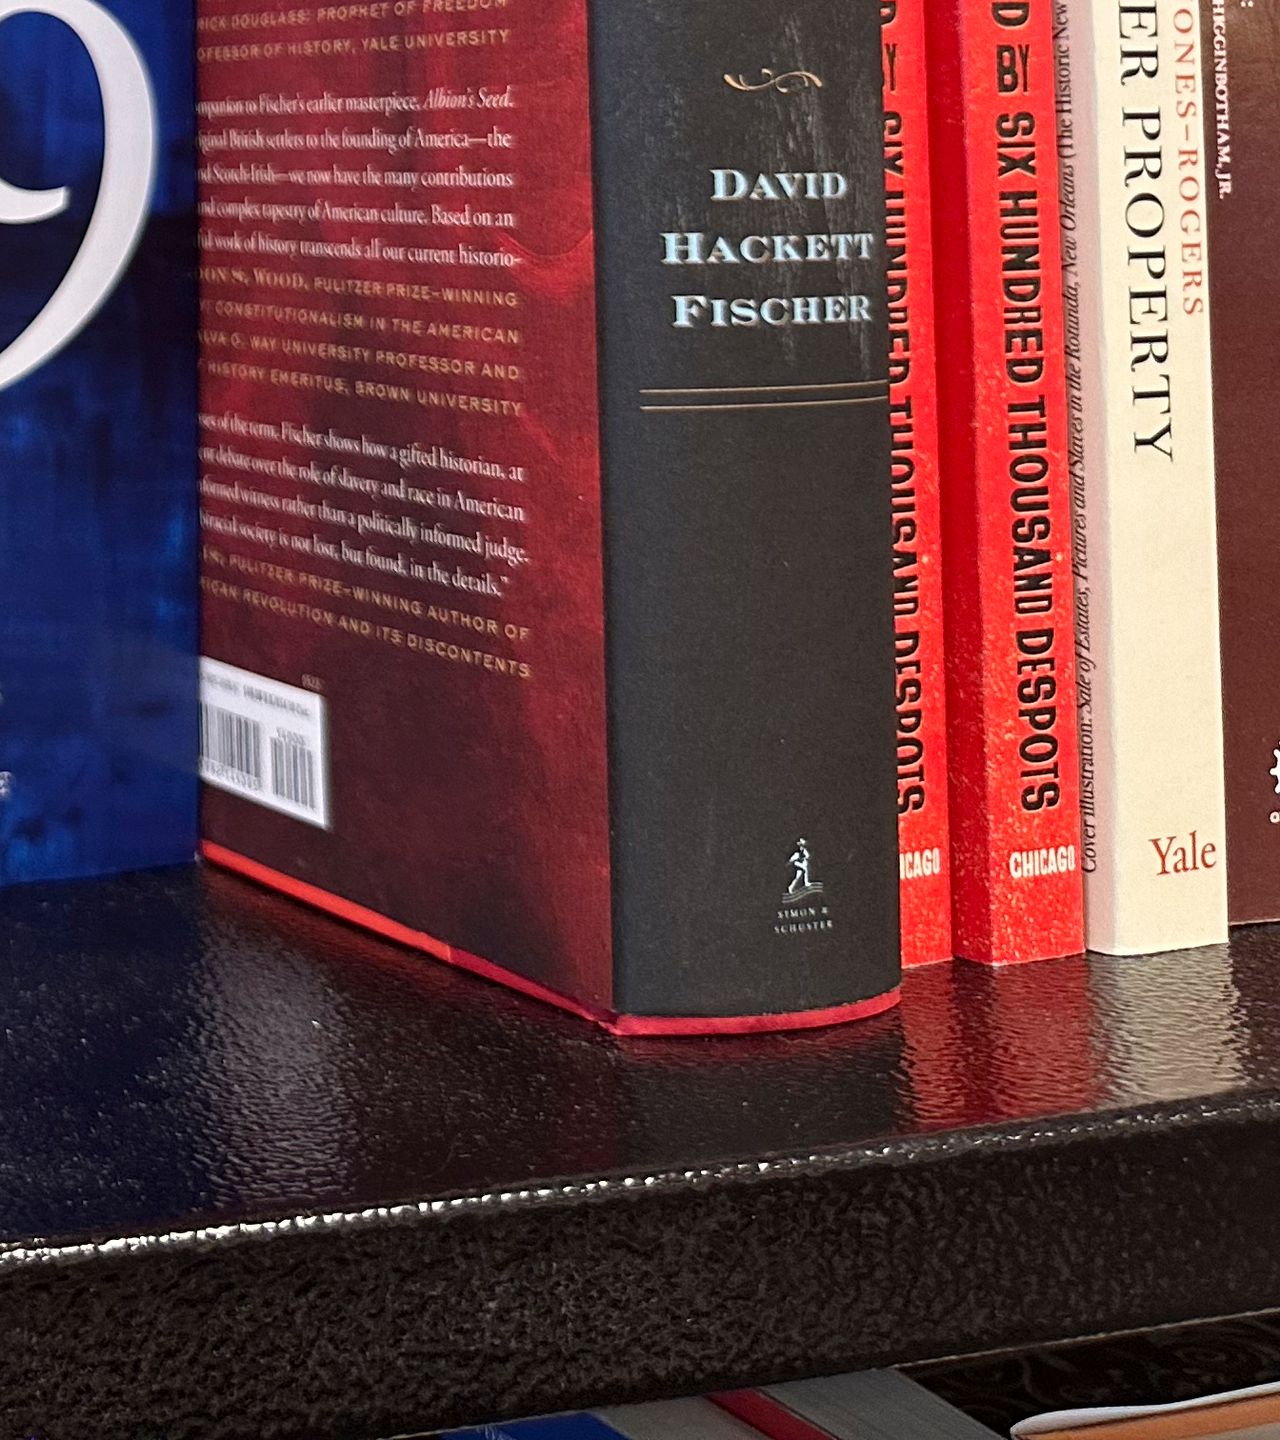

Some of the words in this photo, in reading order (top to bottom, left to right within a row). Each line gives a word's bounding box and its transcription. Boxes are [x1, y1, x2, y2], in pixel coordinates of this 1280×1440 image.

[996, 44, 1030, 93] BY
[996, 112, 1037, 177] SIX
[710, 168, 848, 203] DAVID
[1214, 167, 1233, 200] JR.
[659, 231, 874, 266] HACKETT
[998, 190, 1046, 384] HUNDRED
[1121, 106, 1174, 463] PROPERTY
[671, 294, 872, 329] FISCHER
[1006, 395, 1053, 617] THOUSAND
[1016, 630, 1060, 812] DESPOTS
[1009, 846, 1075, 879] CHICAGO
[1079, 819, 1098, 873] Cover
[1149, 829, 1218, 877] Yale
